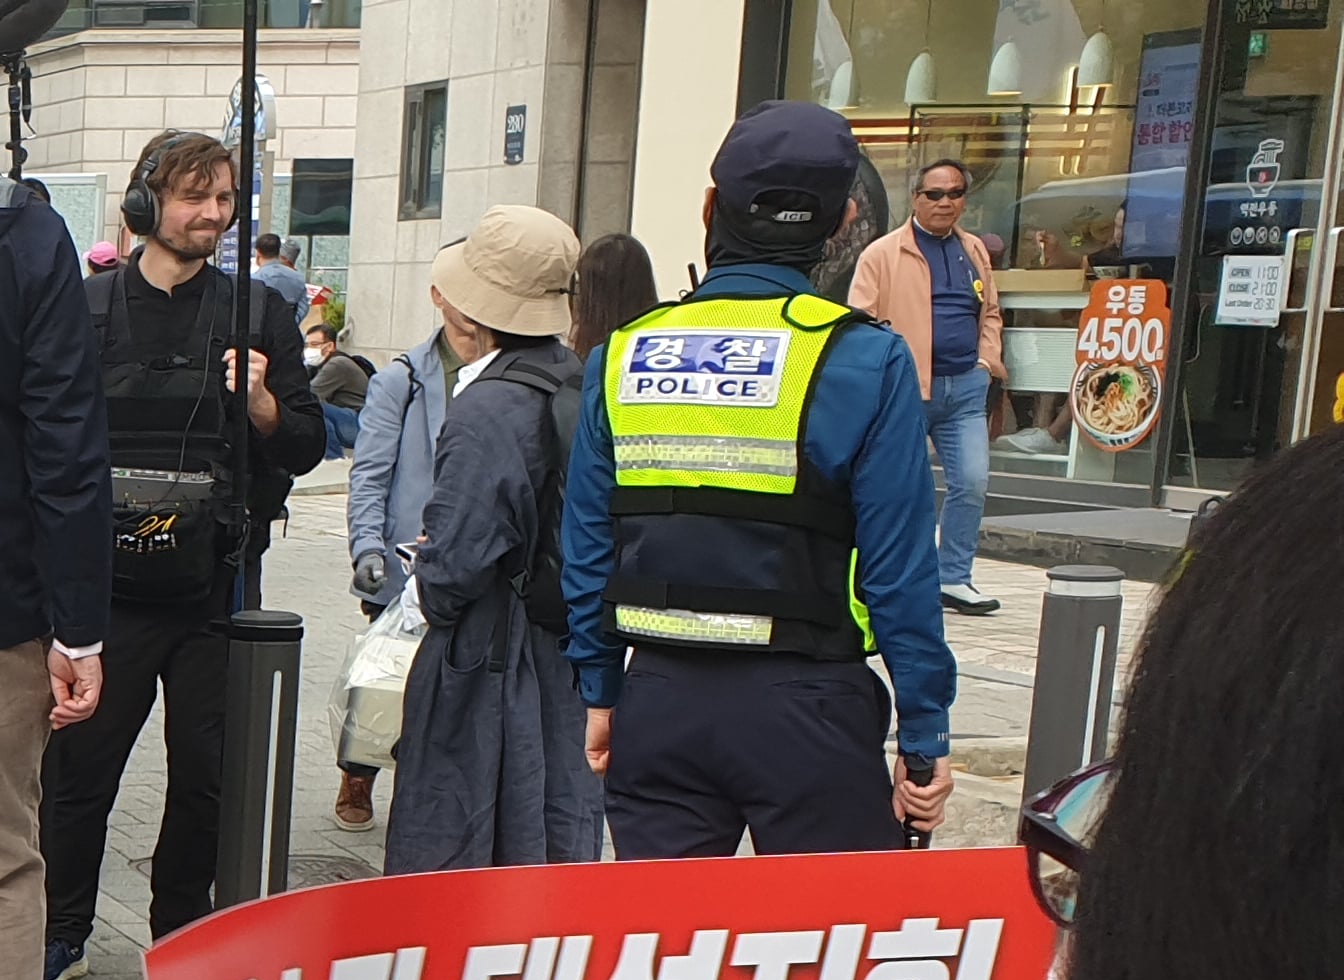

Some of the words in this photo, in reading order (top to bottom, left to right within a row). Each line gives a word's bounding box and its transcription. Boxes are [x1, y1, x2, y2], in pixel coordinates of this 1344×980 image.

[1105, 285, 1147, 315] 우동
[644, 337, 767, 373] 경찰
[636, 377, 759, 397] POLICE
